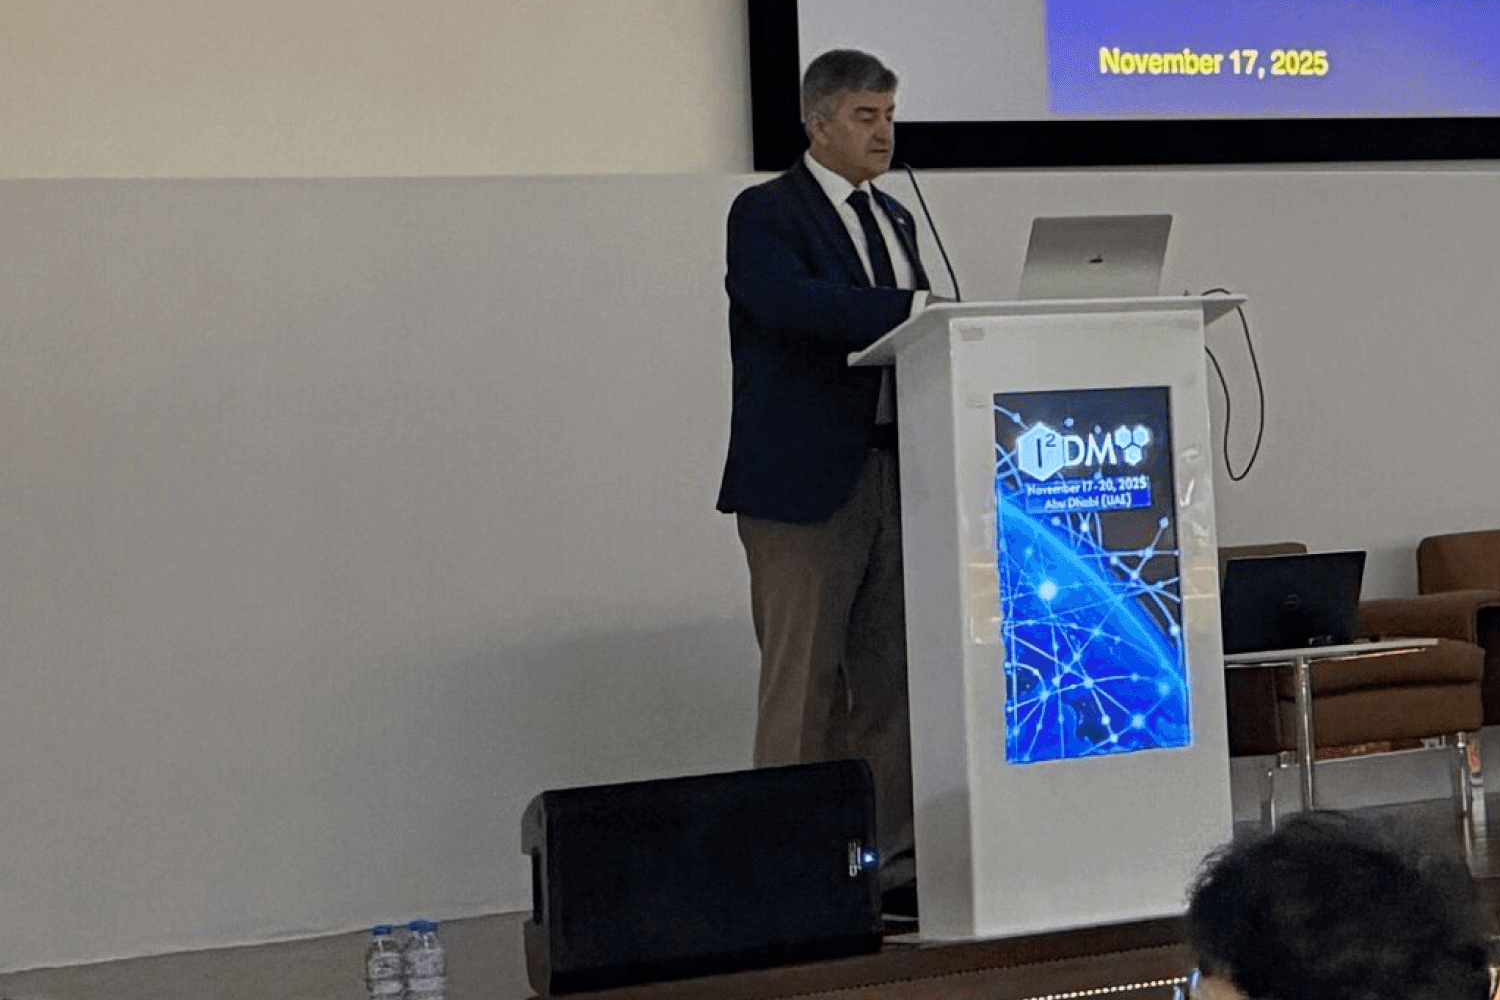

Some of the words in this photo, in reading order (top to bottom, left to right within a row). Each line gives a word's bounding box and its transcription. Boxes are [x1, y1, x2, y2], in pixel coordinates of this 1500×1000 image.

[1099, 46, 1223, 75] November
[1229, 50, 1265, 79] 17,
[1271, 50, 1328, 76] 2025
[1027, 483, 1080, 495] November
[1118, 475, 1148, 490] 2025
[1045, 498, 1066, 510] Abu
[1068, 496, 1099, 509] Dhabi
[1101, 492, 1132, 508] (UAE)
